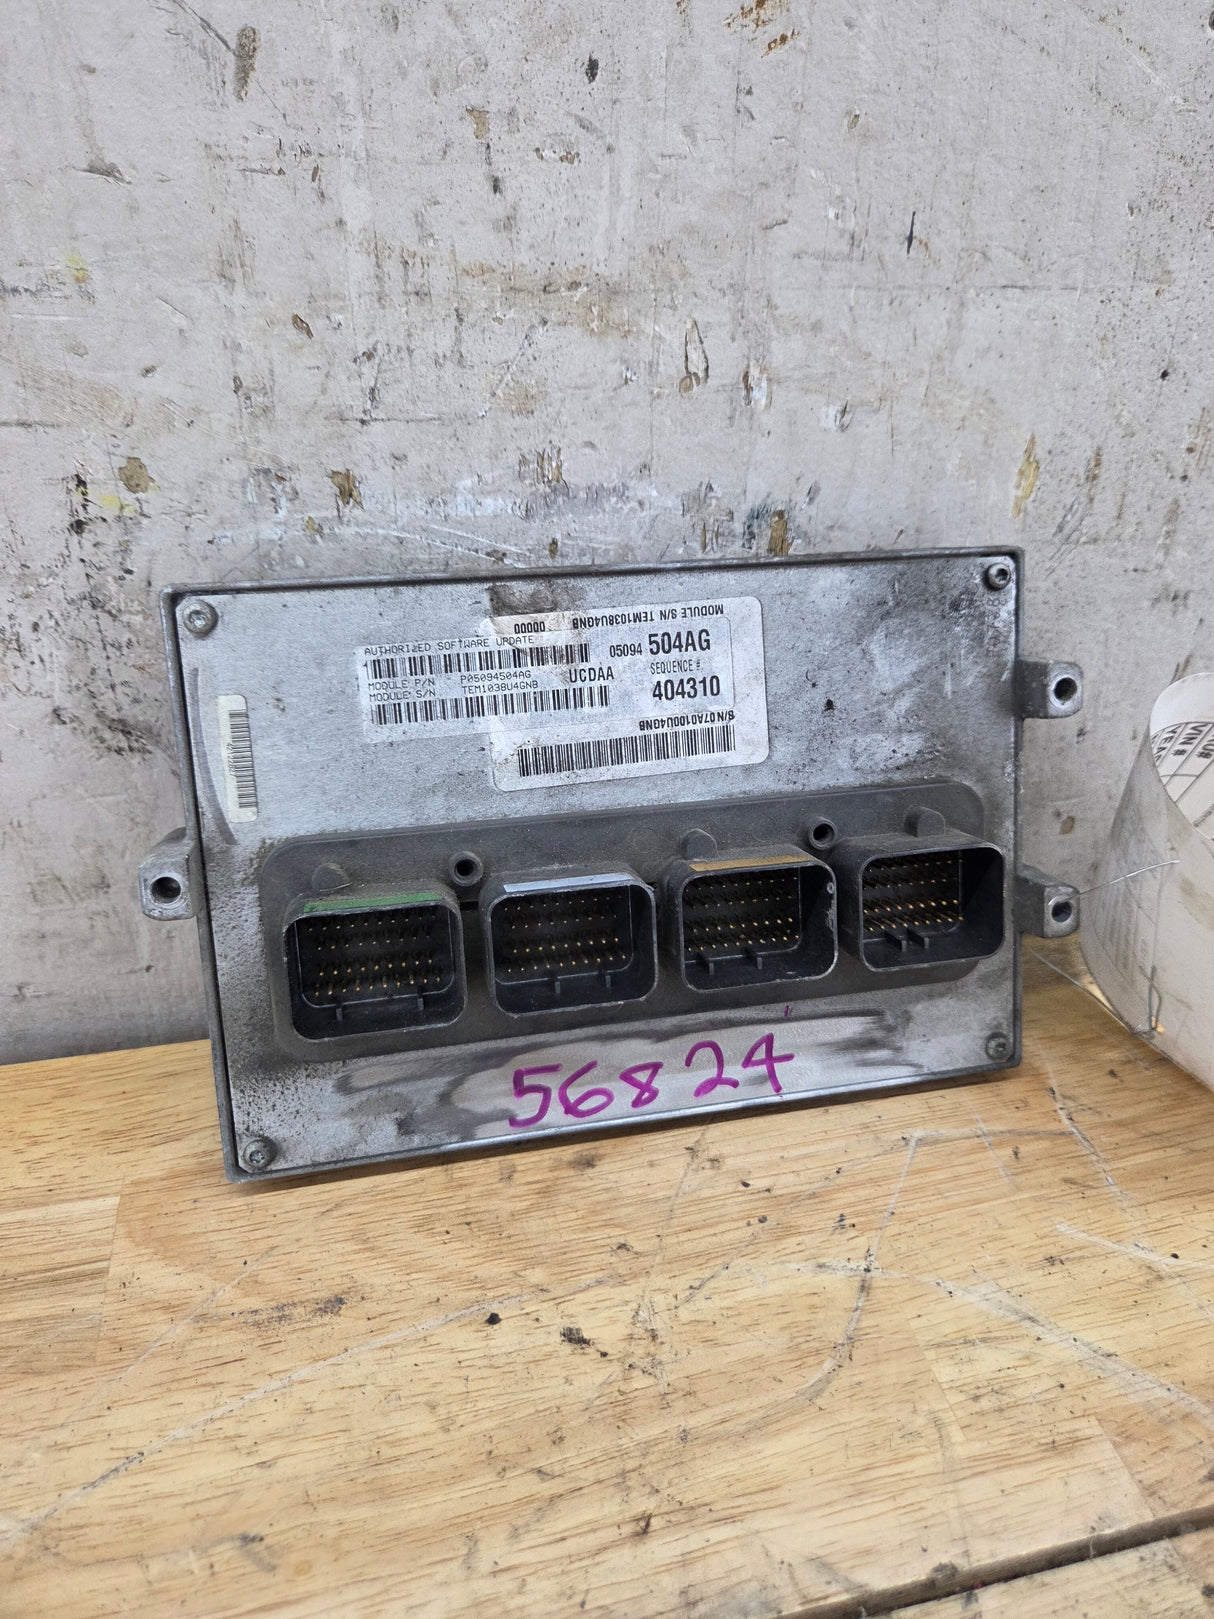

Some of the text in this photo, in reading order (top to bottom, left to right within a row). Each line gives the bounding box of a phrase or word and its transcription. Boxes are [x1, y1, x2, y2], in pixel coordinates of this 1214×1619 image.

[660, 608, 677, 620] S/N
[681, 604, 724, 618] MODULE
[364, 635, 535, 656] AUTHORIZED SOFTWARE UPDATE
[609, 629, 711, 657] 05094 504AG
[569, 666, 615, 683] UCDAA
[650, 659, 693, 675] SEQUENCE
[368, 670, 532, 691] MODULE P/N P05094504AG
[652, 675, 721, 701] 404310
[369, 681, 539, 702] MODULE S/N TEM1038U4GNB
[1178, 722, 1208, 746] VIN
